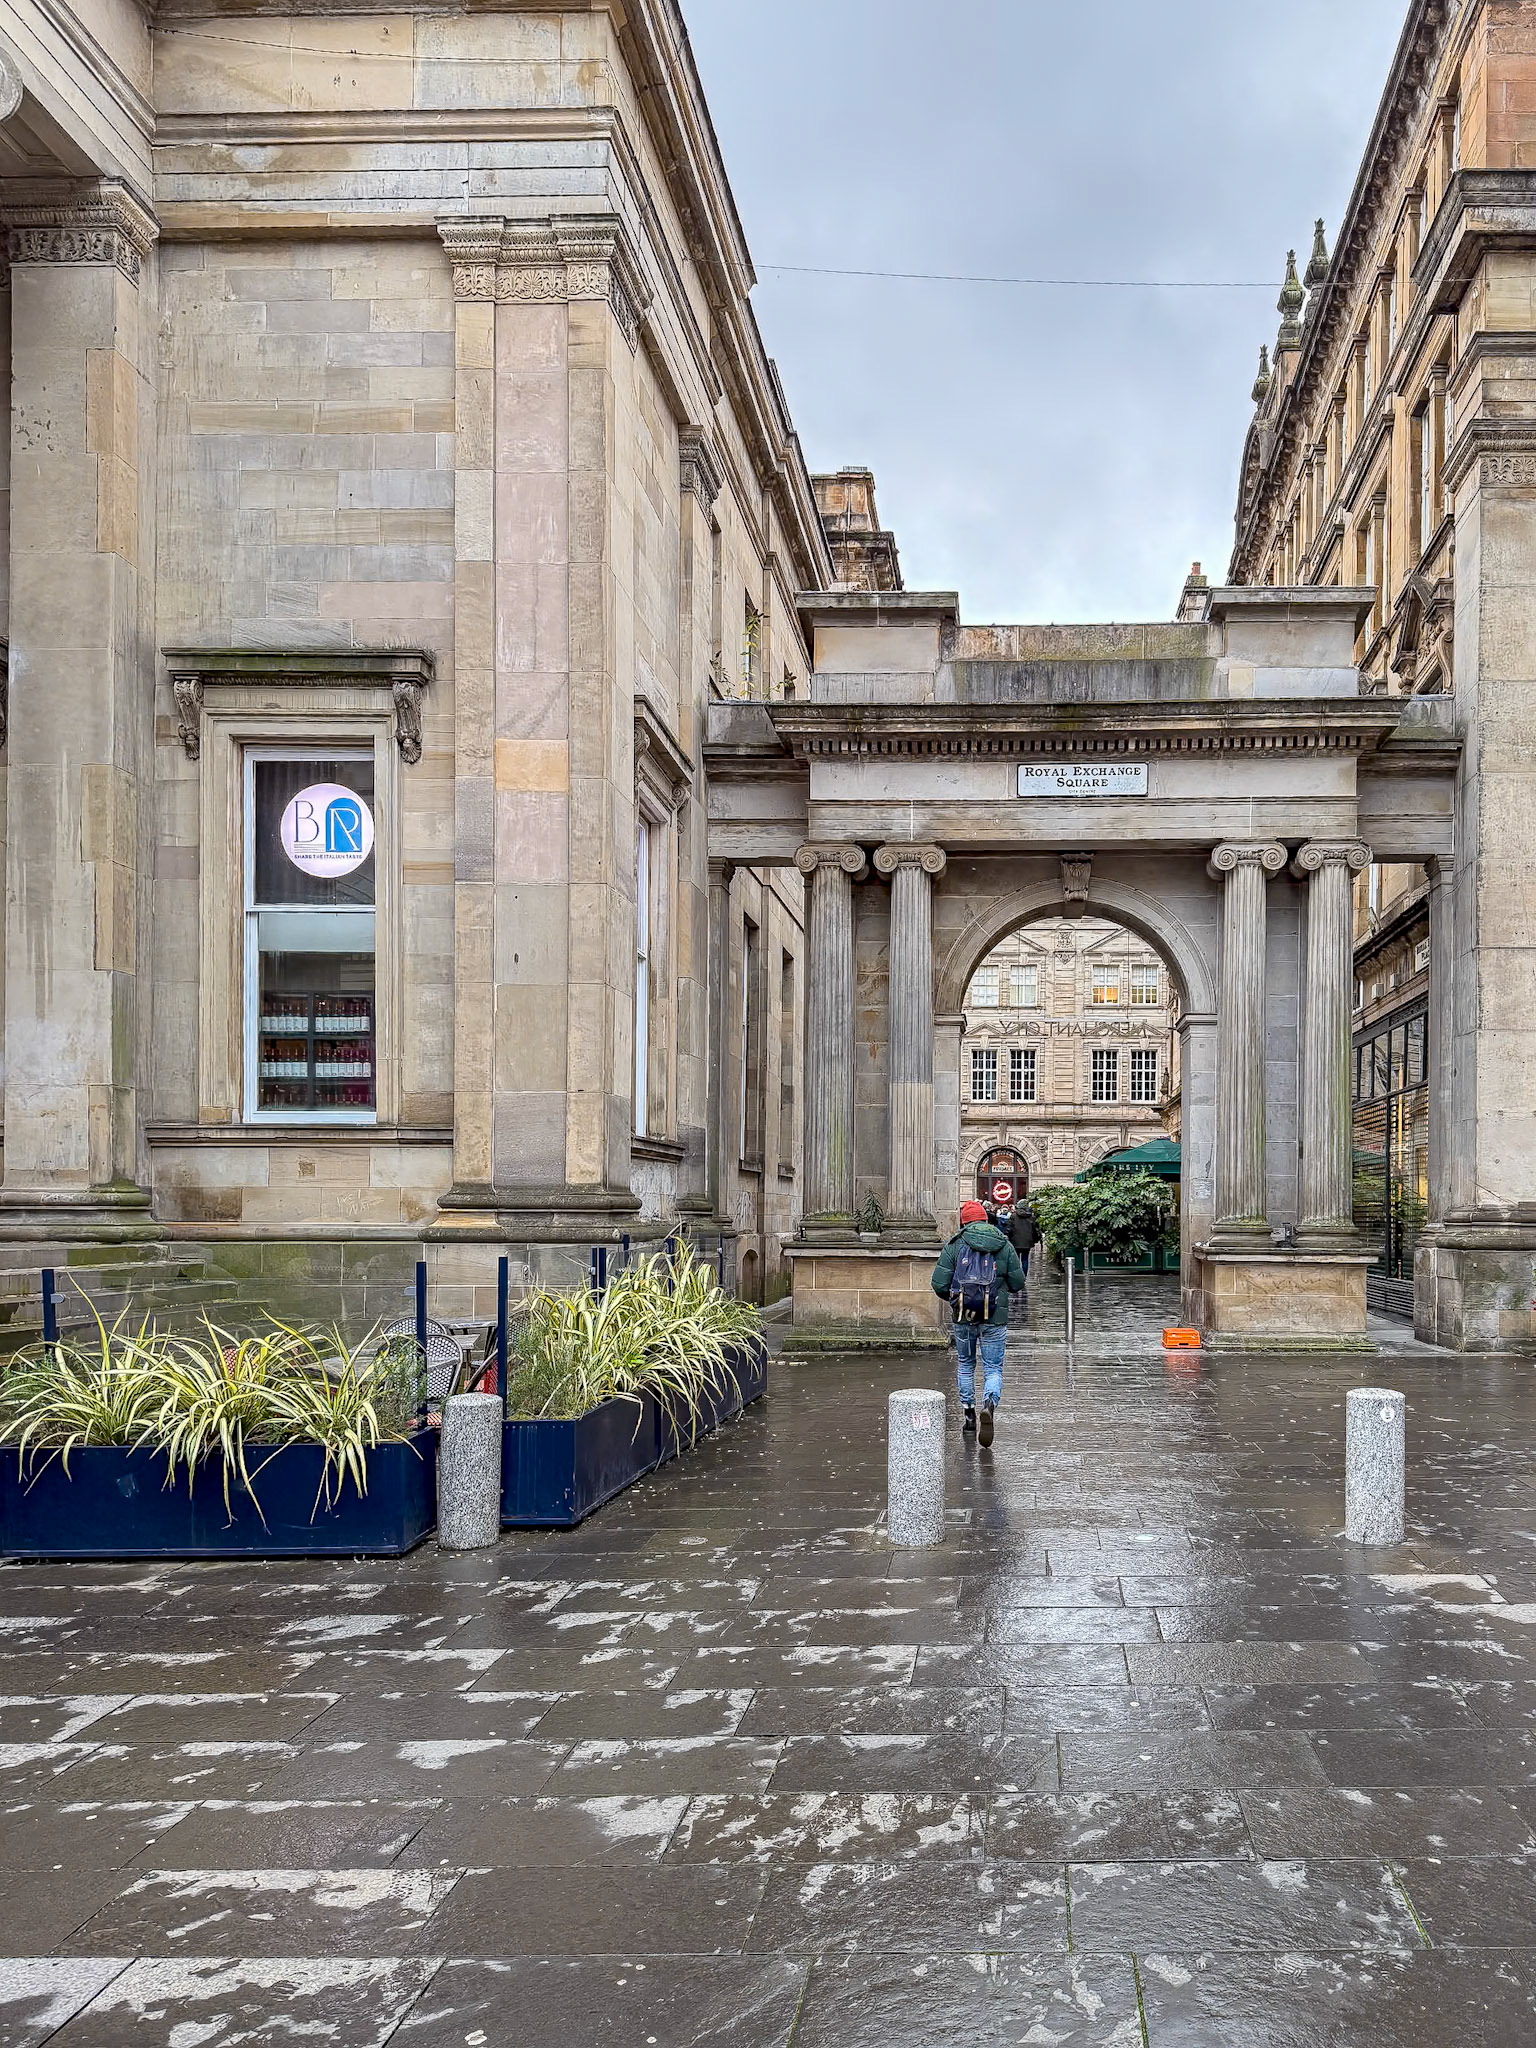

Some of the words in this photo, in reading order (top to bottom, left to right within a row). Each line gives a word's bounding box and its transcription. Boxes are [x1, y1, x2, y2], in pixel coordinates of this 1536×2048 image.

[1025, 767, 1067, 777] ROYAL
[1073, 766, 1141, 776] EXCHANGE
[1056, 777, 1109, 788] SQUARE
